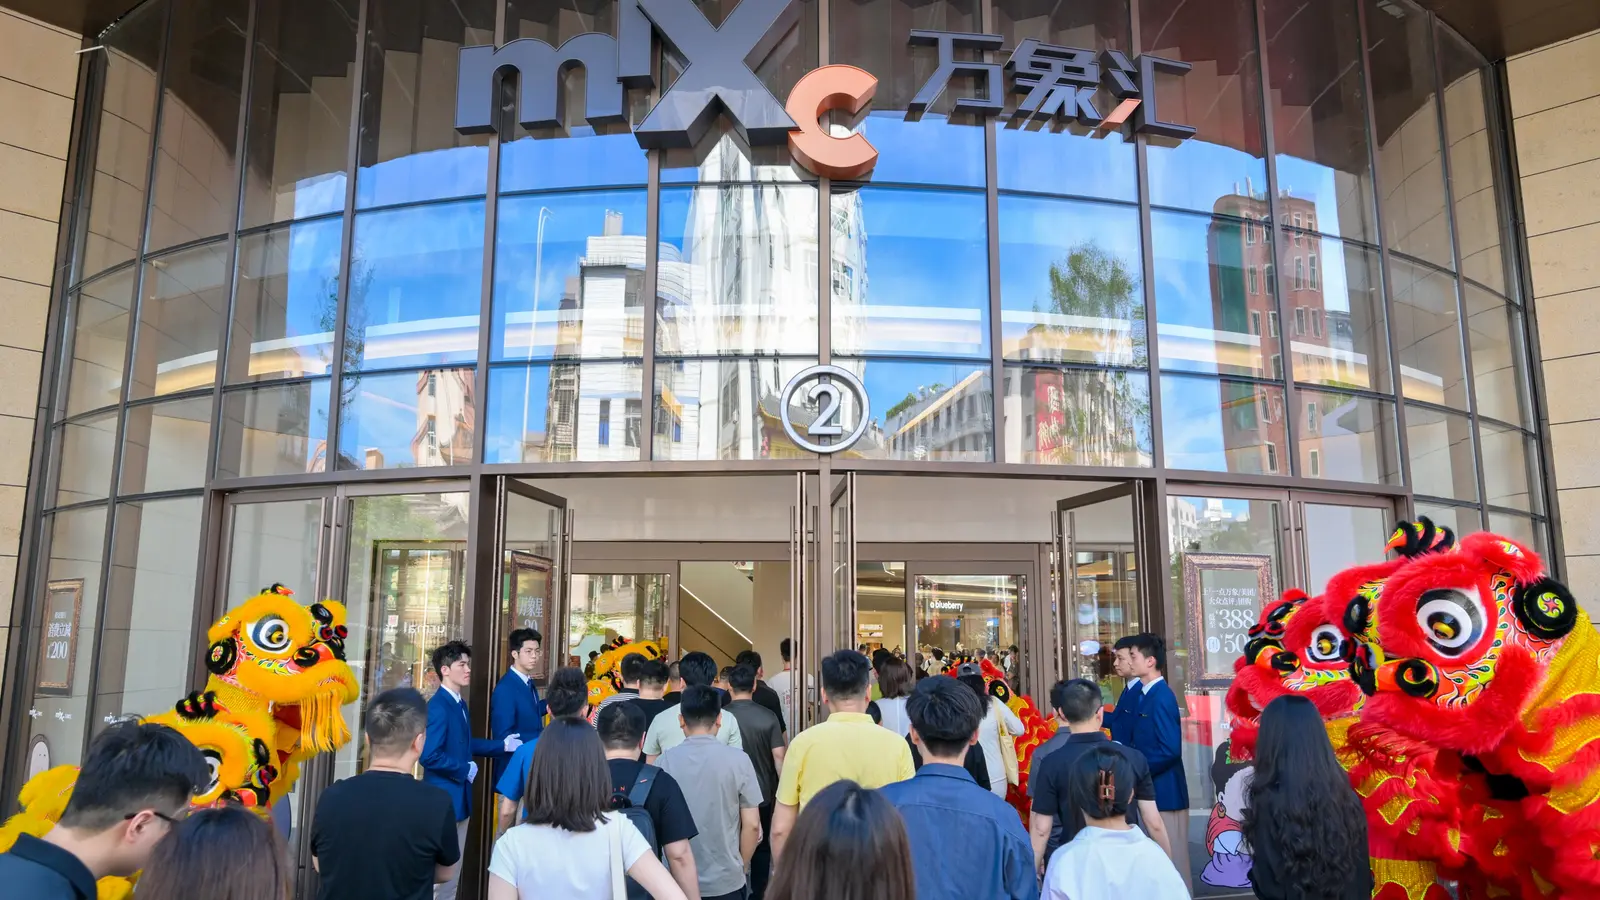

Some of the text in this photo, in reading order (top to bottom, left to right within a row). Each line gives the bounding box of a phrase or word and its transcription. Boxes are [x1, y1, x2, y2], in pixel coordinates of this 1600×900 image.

[906, 29, 1197, 140] 万象汇
[807, 383, 843, 436] 2
[936, 600, 963, 612] blueberry
